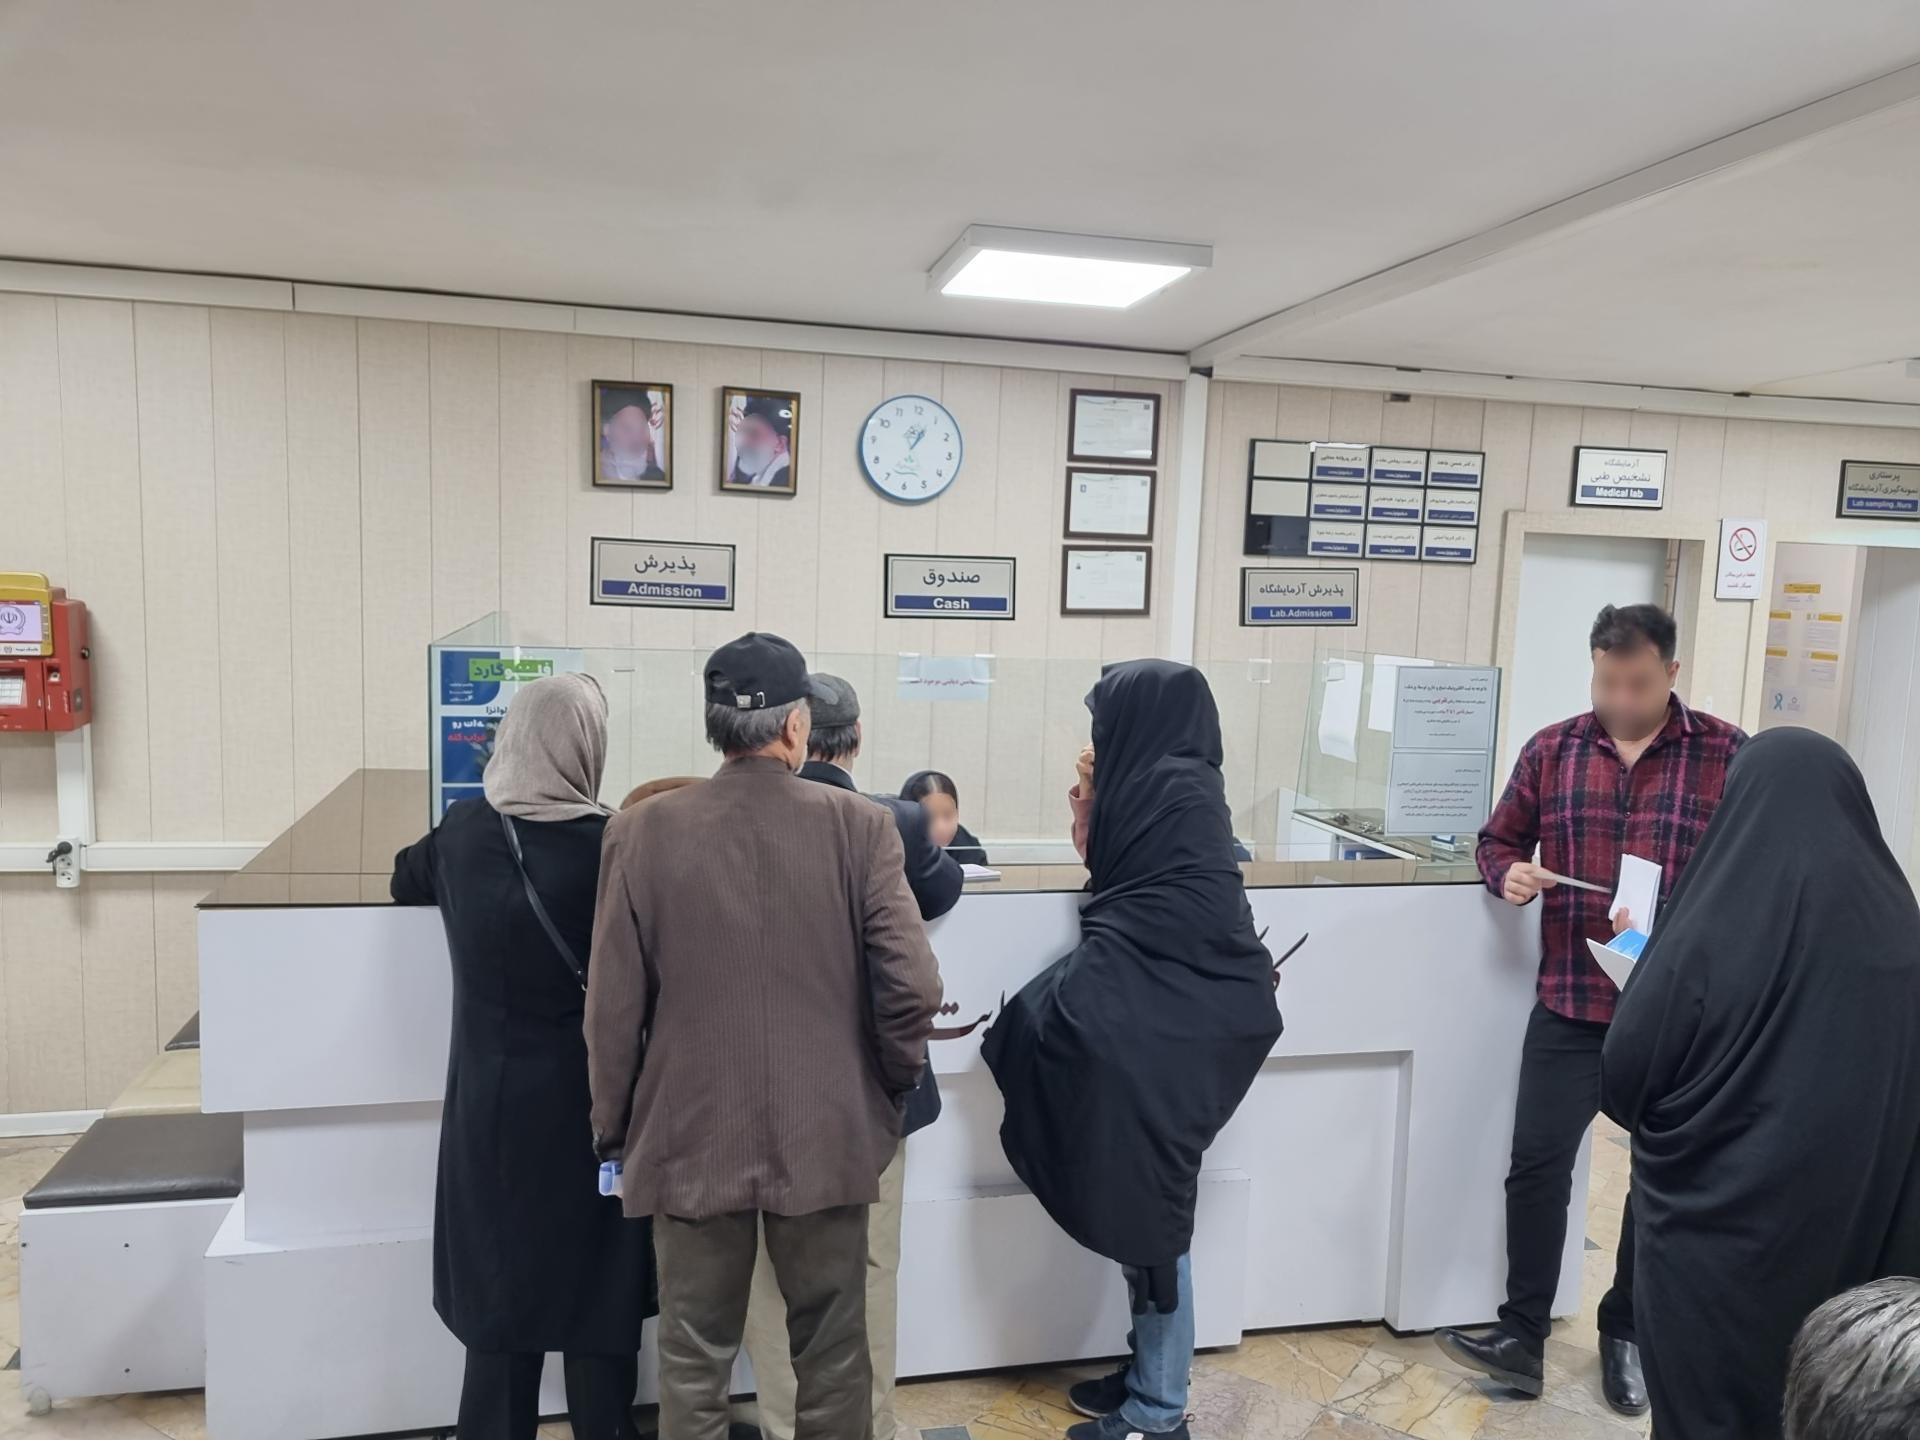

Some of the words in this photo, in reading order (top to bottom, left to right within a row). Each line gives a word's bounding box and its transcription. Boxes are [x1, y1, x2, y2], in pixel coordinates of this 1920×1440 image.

[944, 434, 950, 442] 2
[946, 453, 952, 461] 3
[886, 473, 891, 481] 7
[1595, 486, 1629, 498] Medical
[1630, 488, 1645, 498] lab
[634, 554, 697, 577] پذیرش
[923, 568, 981, 588] صندوق
[628, 582, 702, 598] Admission
[1259, 582, 1306, 596] آزمایشگاه
[1308, 584, 1344, 597] پذیرش
[932, 597, 970, 609] Cash
[1269, 608, 1333, 618] Lab.Admission
